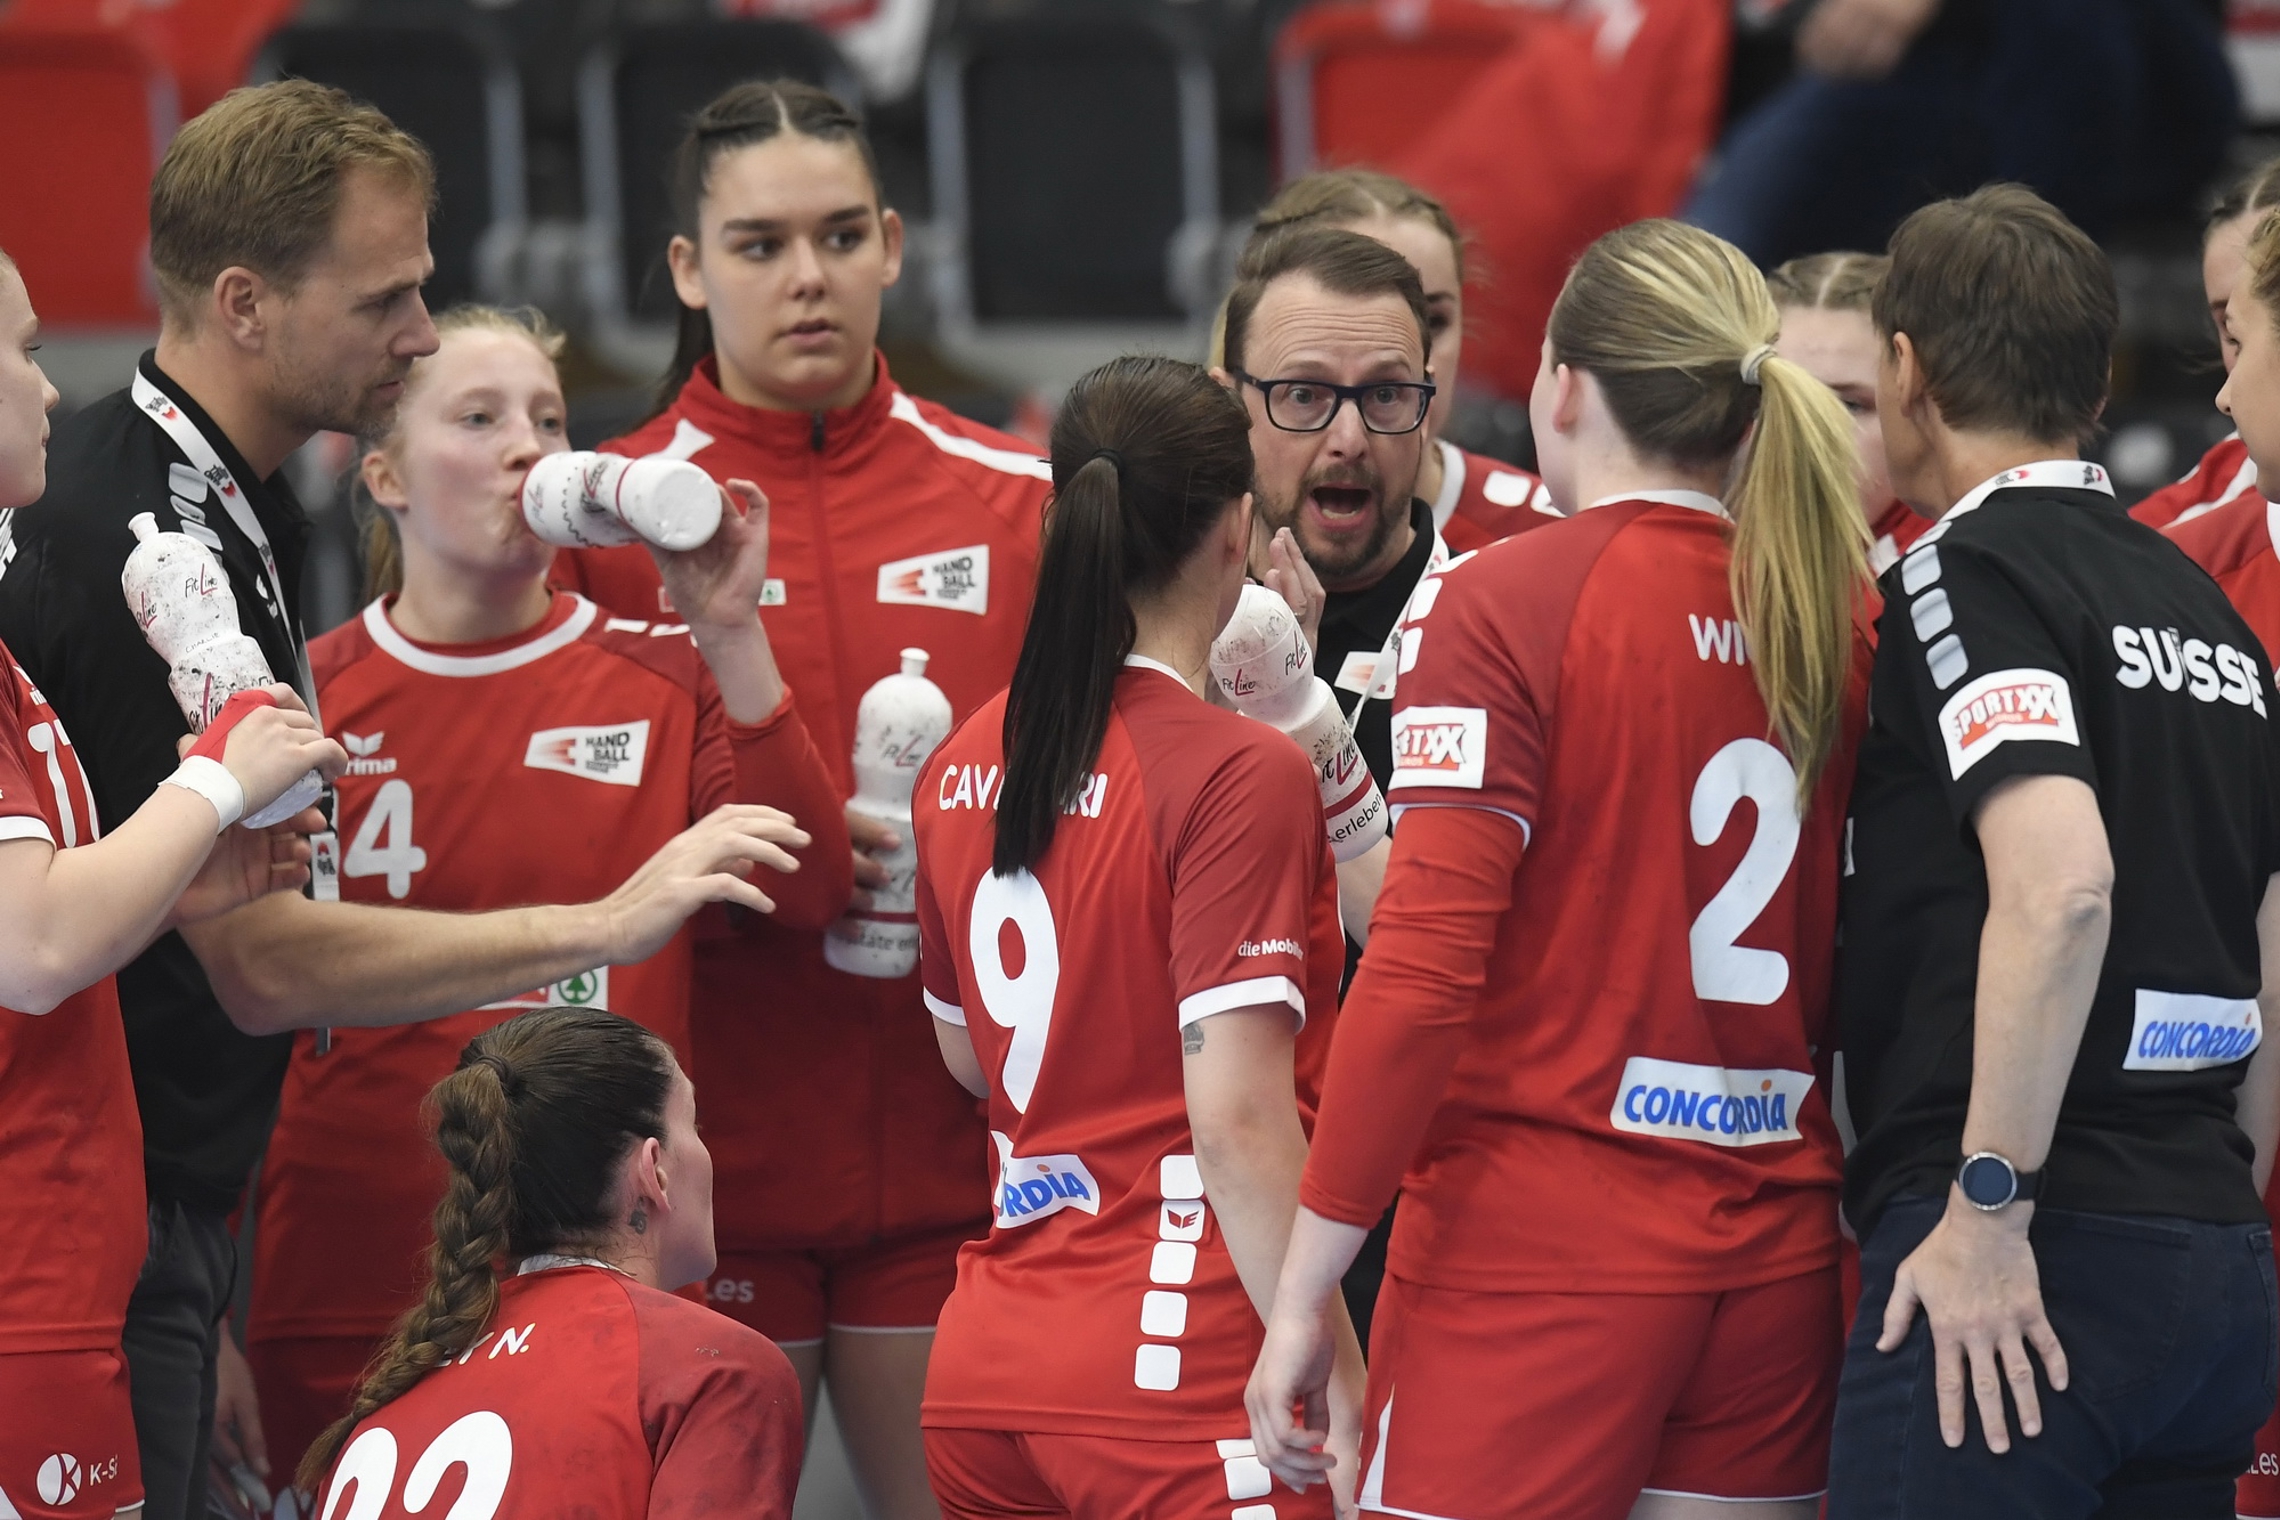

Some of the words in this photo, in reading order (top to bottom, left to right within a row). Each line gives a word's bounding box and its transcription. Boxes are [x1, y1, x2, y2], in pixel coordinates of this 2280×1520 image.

[1688, 613, 1745, 666] WI
[1223, 669, 1256, 696] FitLine
[585, 732, 630, 749] HAND
[594, 748, 630, 761] BALL
[343, 778, 427, 899] 4
[1335, 794, 1383, 840] erleben
[1689, 737, 1801, 1006] 2
[1238, 940, 1260, 957] die
[969, 865, 1060, 1115] 9
[2138, 1012, 2256, 1058] CONCORDIA
[1624, 1079, 1788, 1134] CONCORDIA
